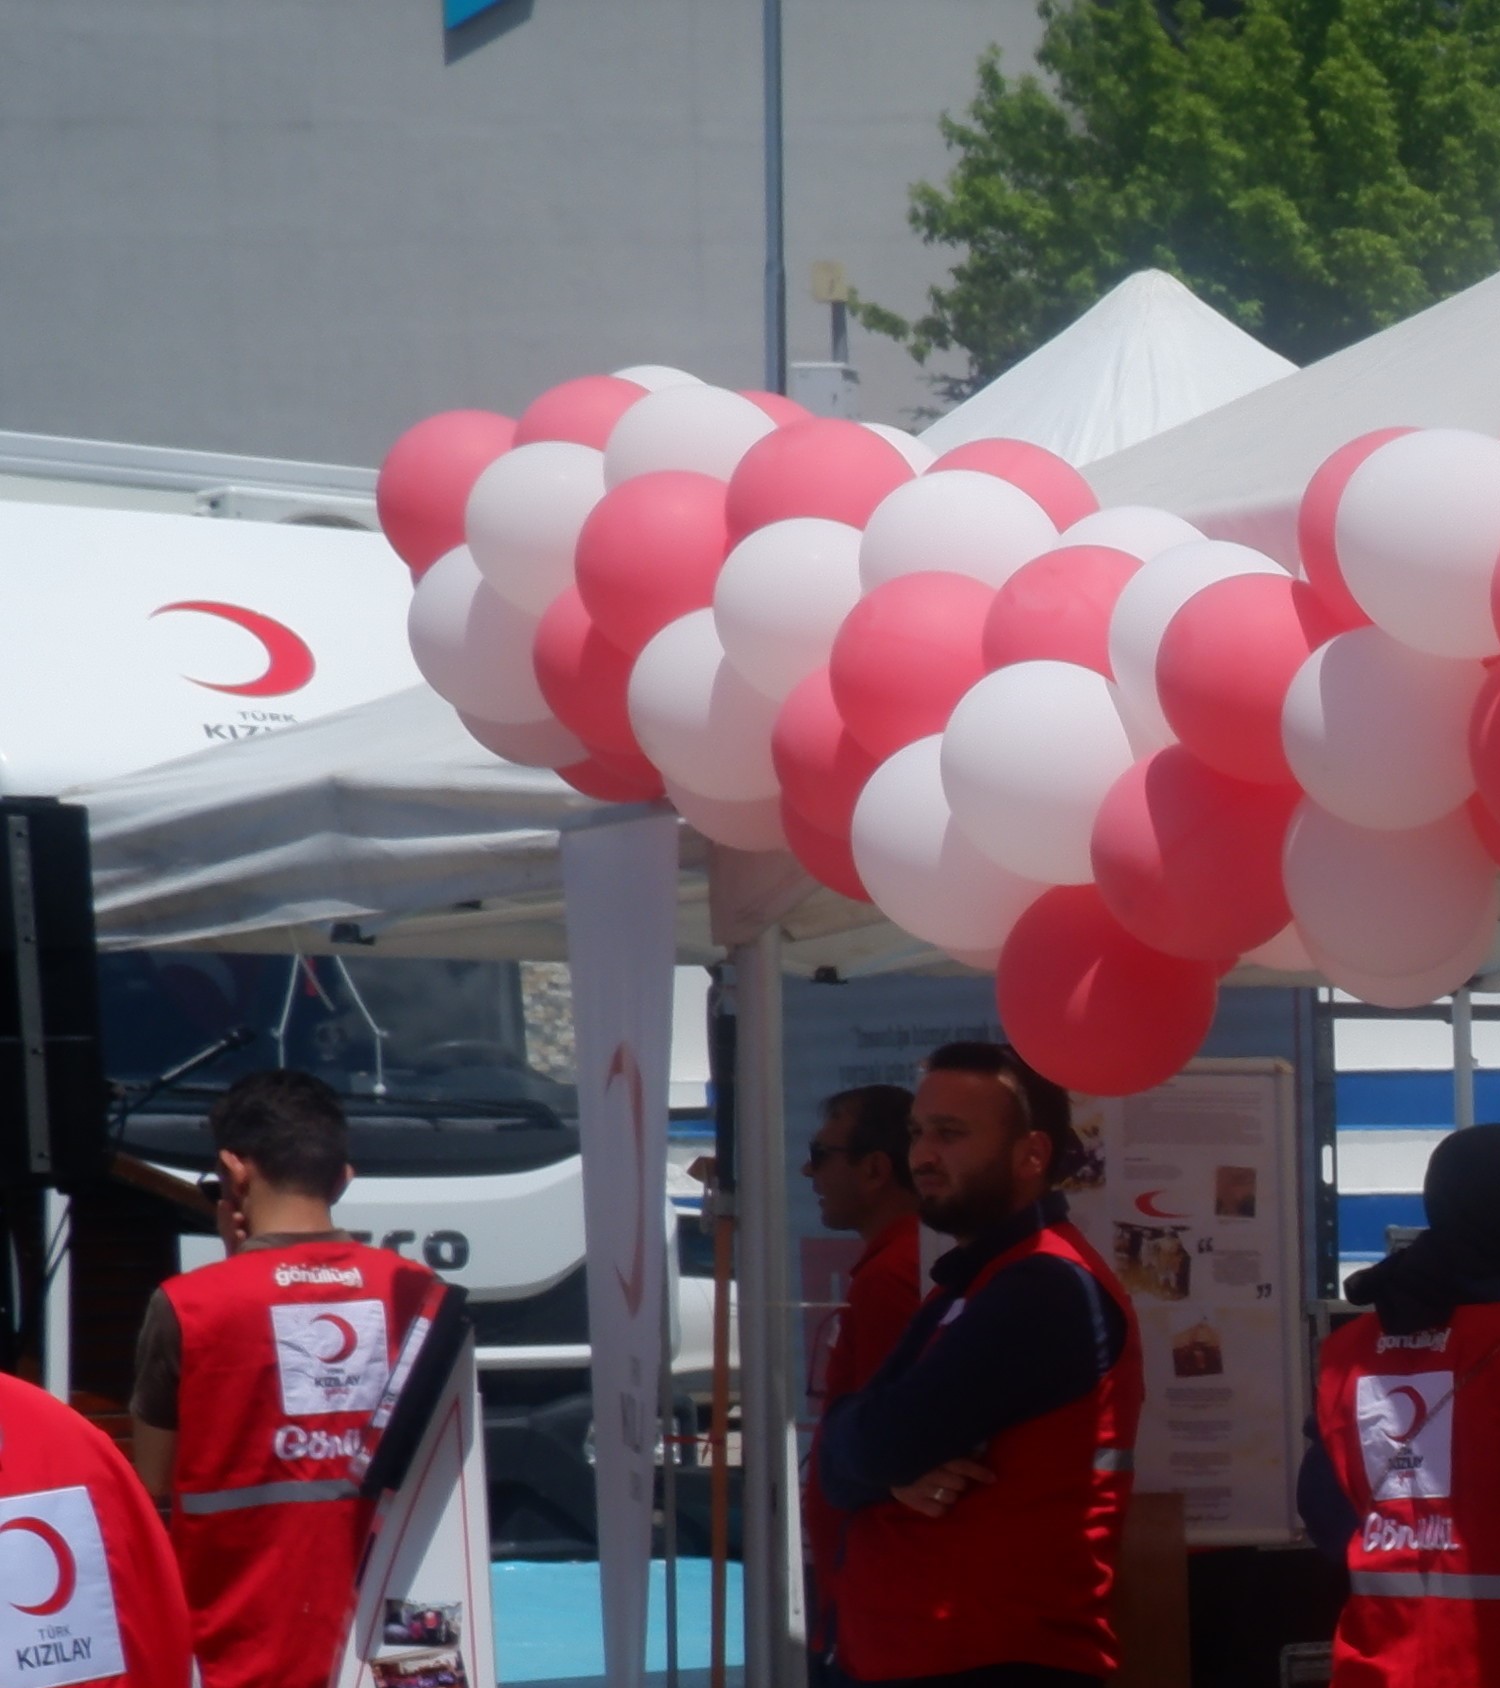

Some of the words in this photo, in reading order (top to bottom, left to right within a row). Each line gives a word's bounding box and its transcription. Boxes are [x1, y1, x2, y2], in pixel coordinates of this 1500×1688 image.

[238, 710, 299, 723] TÜRK
[38, 1624, 71, 1641] TÜRK
[16, 1636, 92, 1671] KIZILAY
